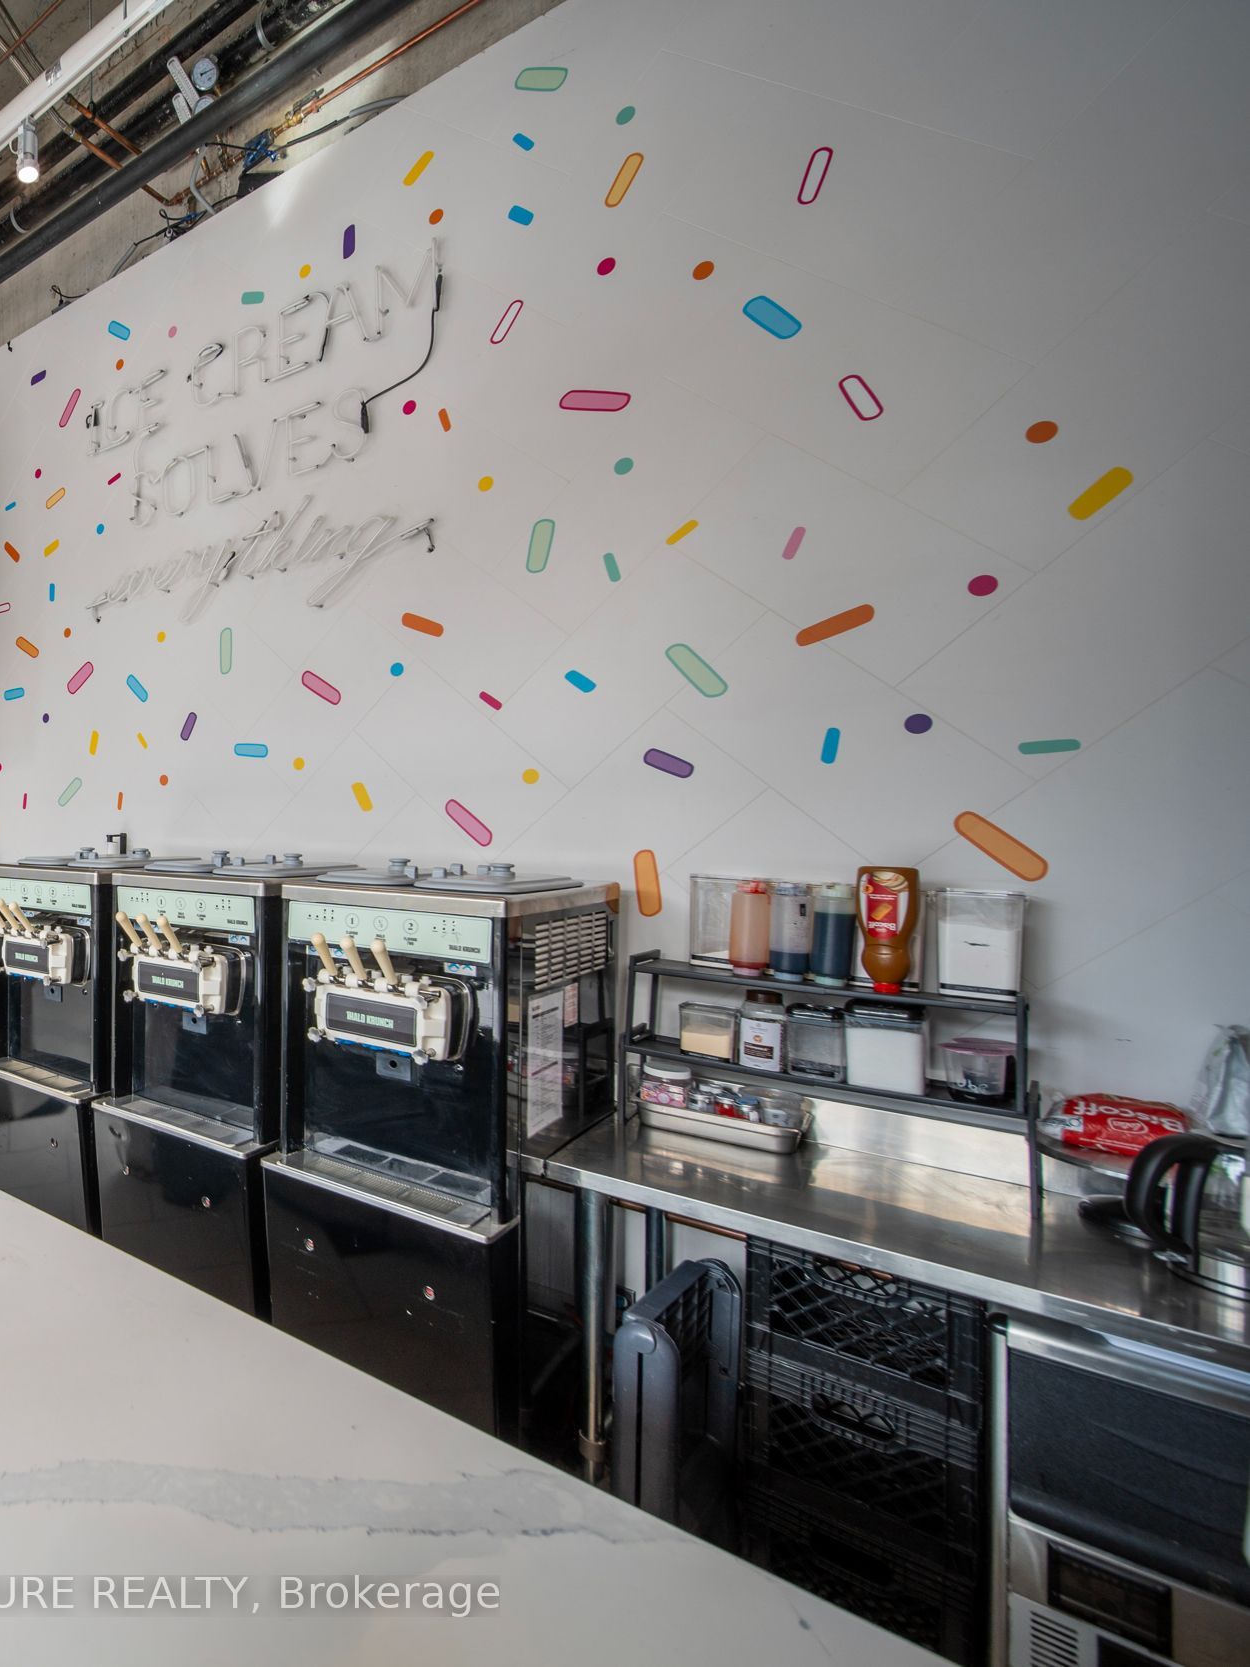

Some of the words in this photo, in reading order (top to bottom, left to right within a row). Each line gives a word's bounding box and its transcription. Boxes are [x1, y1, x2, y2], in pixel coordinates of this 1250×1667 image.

[87, 369, 167, 457] ICE
[187, 237, 442, 407] CREAM
[129, 387, 371, 527] SOLVES
[85, 495, 436, 624] everything
[1072, 1101, 1186, 1134] Biscoff
